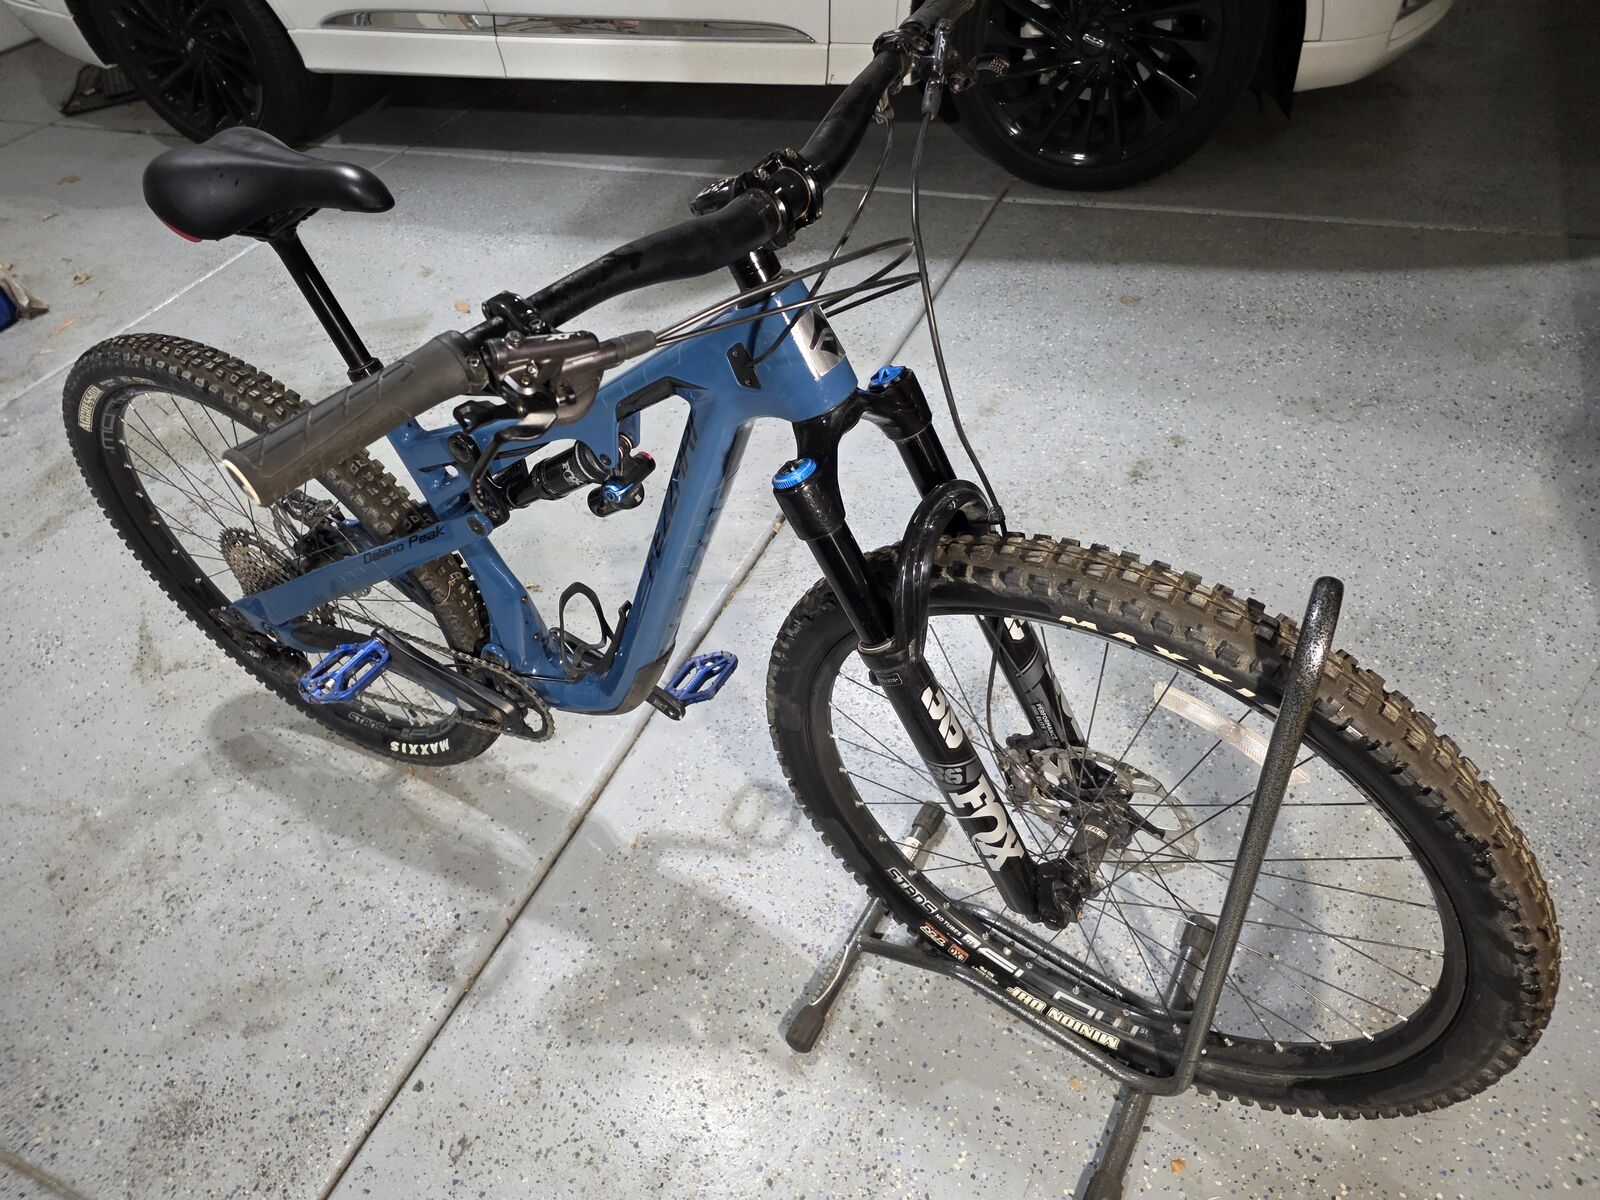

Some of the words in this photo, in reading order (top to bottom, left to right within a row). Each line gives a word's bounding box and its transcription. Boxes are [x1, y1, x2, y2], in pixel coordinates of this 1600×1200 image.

[78, 384, 104, 433] AGGRESSOR
[363, 543, 404, 564] Delano
[408, 525, 445, 549] Peak
[1059, 615, 1279, 716] MAXXI
[390, 738, 450, 755] MAXXIS
[888, 867, 938, 914] STANS
[1006, 986, 1047, 1013] DHF
[1046, 1007, 1120, 1050] MINION
